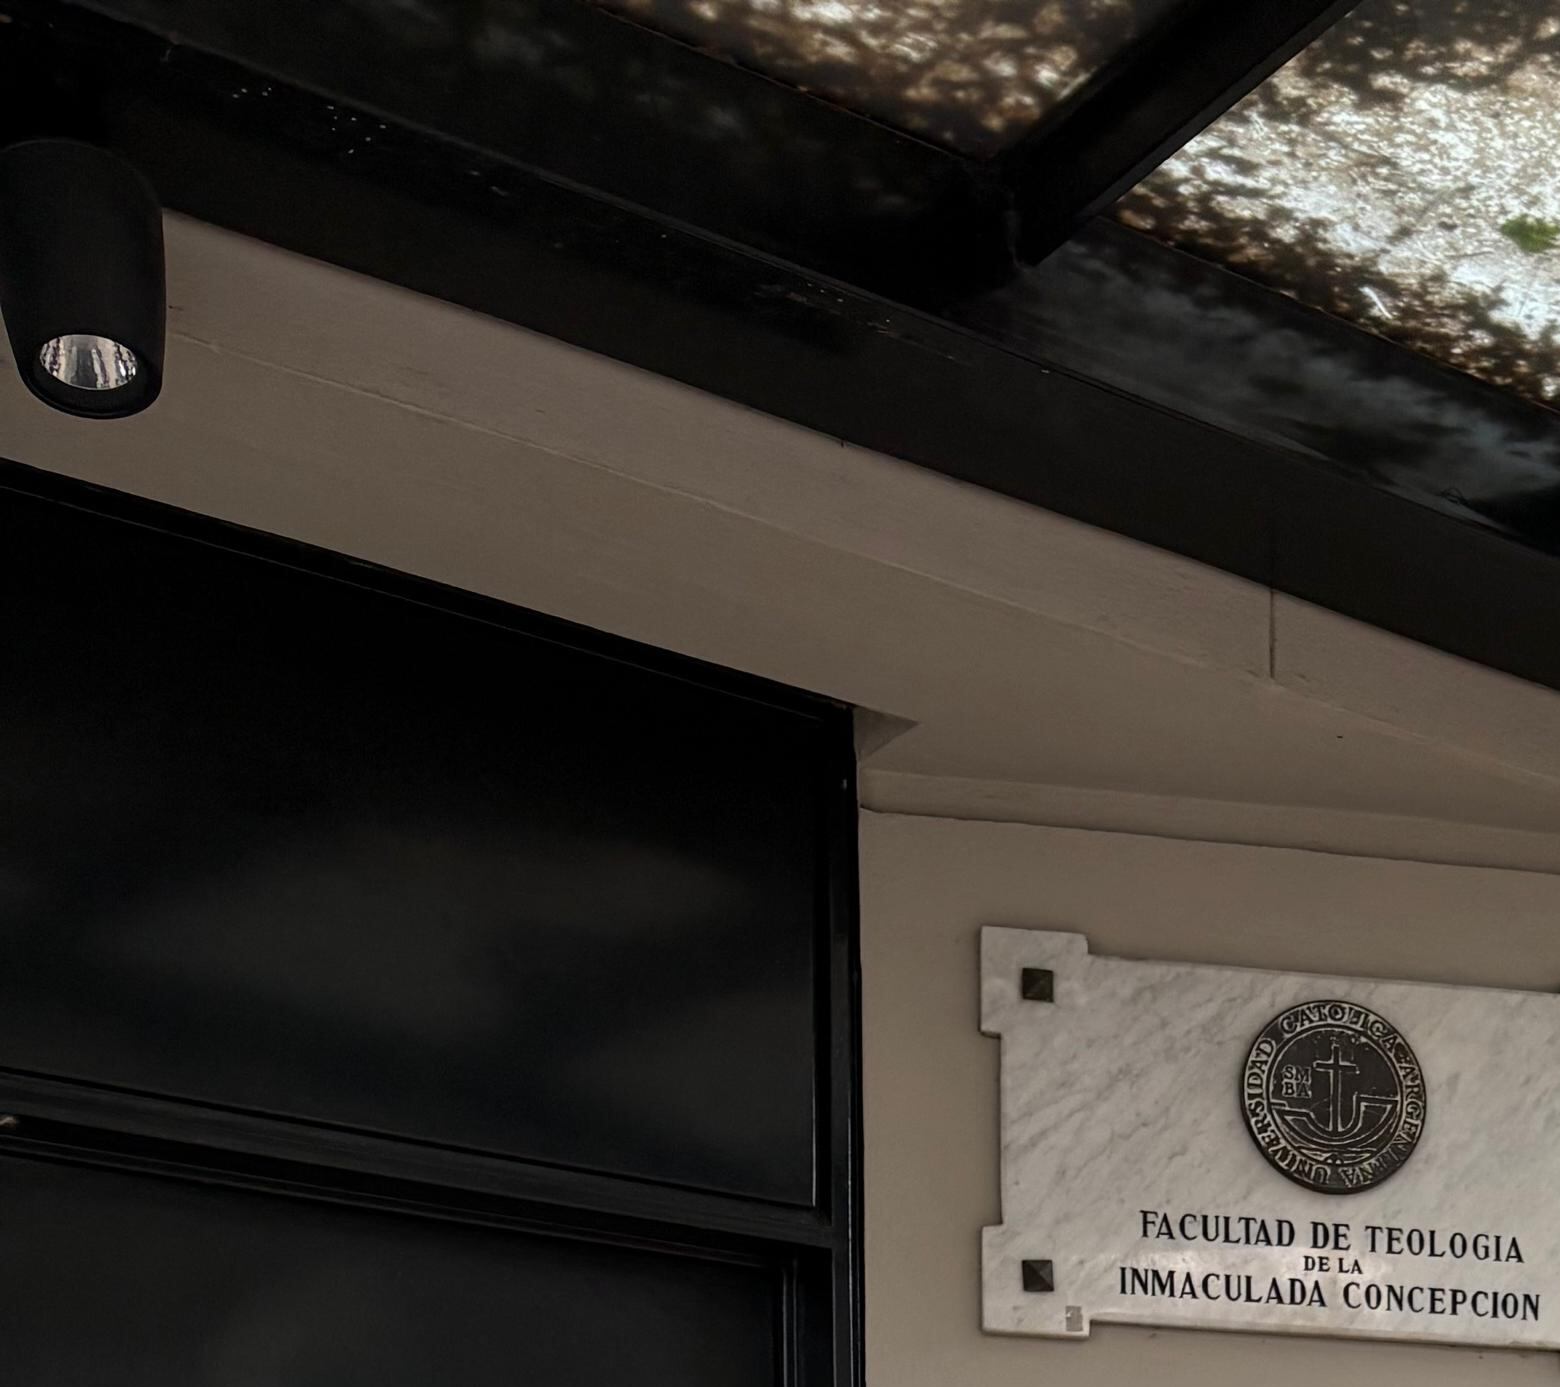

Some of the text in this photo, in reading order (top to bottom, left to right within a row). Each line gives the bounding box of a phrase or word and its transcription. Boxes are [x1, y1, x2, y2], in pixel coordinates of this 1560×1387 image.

[1280, 1004, 1398, 1053] CATOLICA
[1283, 1065, 1311, 1081] SM
[1283, 1081, 1311, 1098] BA
[1246, 1038, 1331, 1185] UNIVERSIDAD
[1140, 1211, 1525, 1263] FACULTAD DE TEOLOGIA
[1303, 1256, 1363, 1274] DE LA
[1119, 1267, 1540, 1321] INMACULADA CONCEPCION
